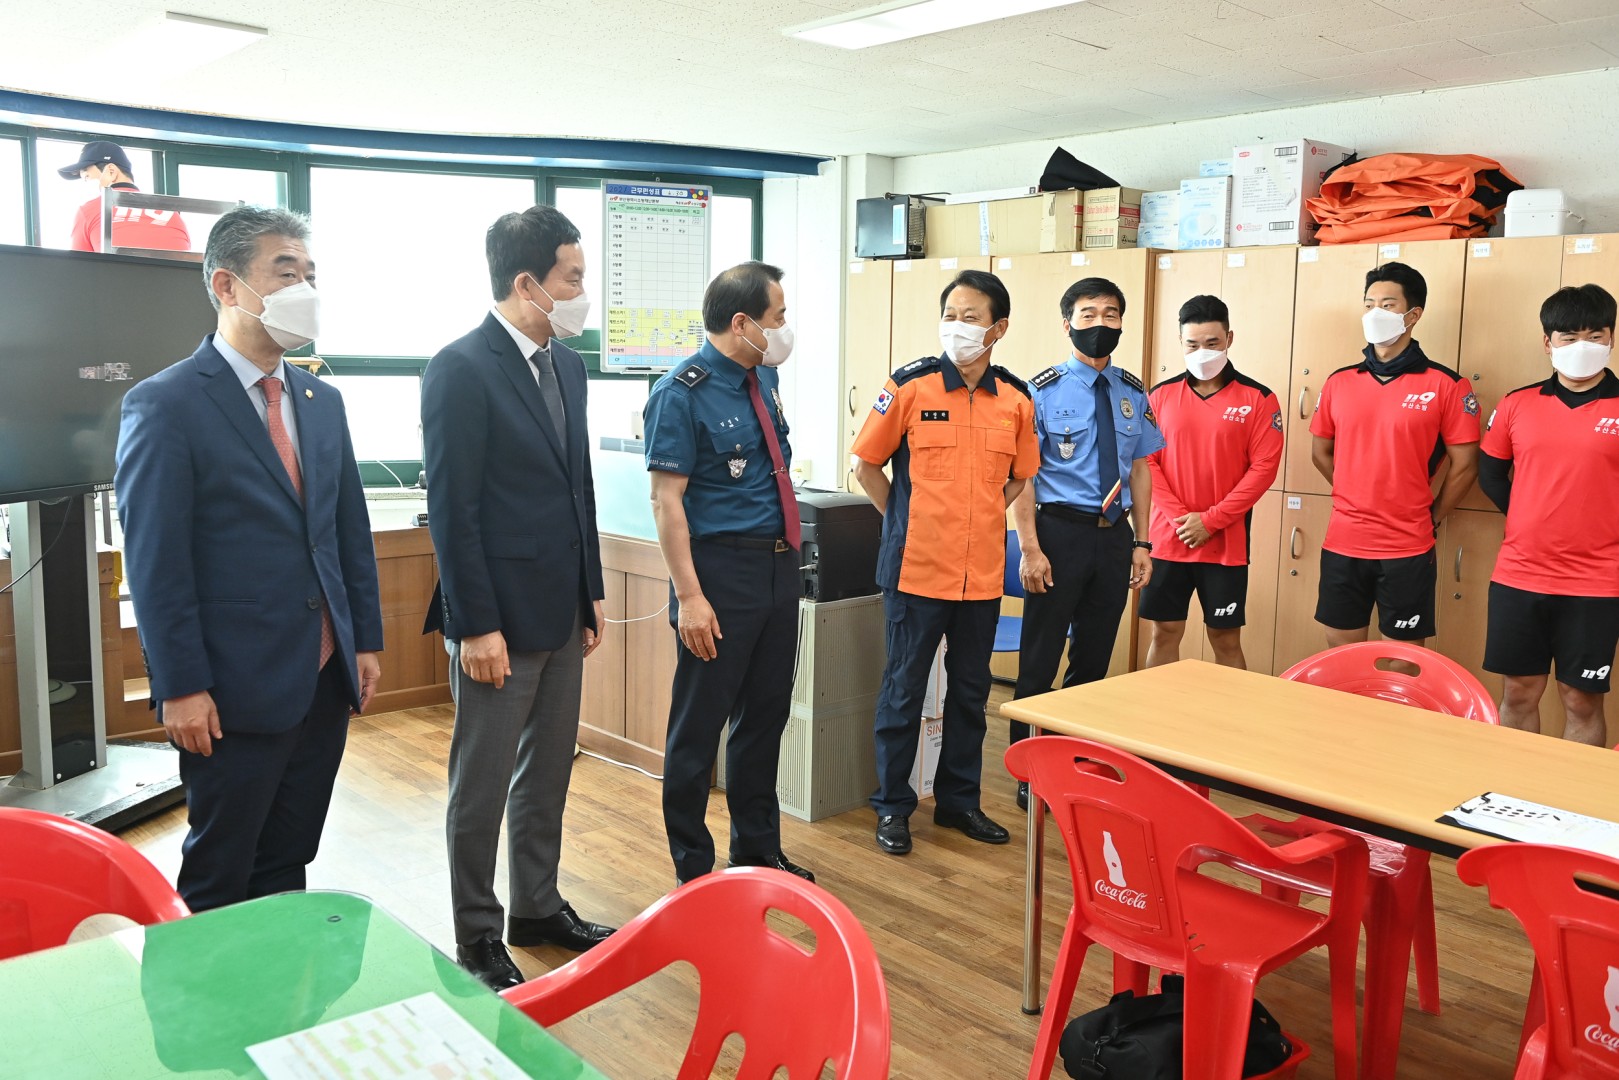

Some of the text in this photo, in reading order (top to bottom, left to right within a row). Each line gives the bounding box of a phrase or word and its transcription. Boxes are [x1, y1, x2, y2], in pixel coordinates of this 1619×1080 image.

[1402, 391, 1436, 404] 119
[1224, 405, 1252, 417] 119
[1594, 426, 1619, 437] 부산소
[93, 483, 114, 491] SAMSU
[1214, 602, 1237, 616] 119
[1394, 614, 1421, 629] 119
[1581, 664, 1611, 680] 119
[1094, 879, 1148, 909] Coca-Cola
